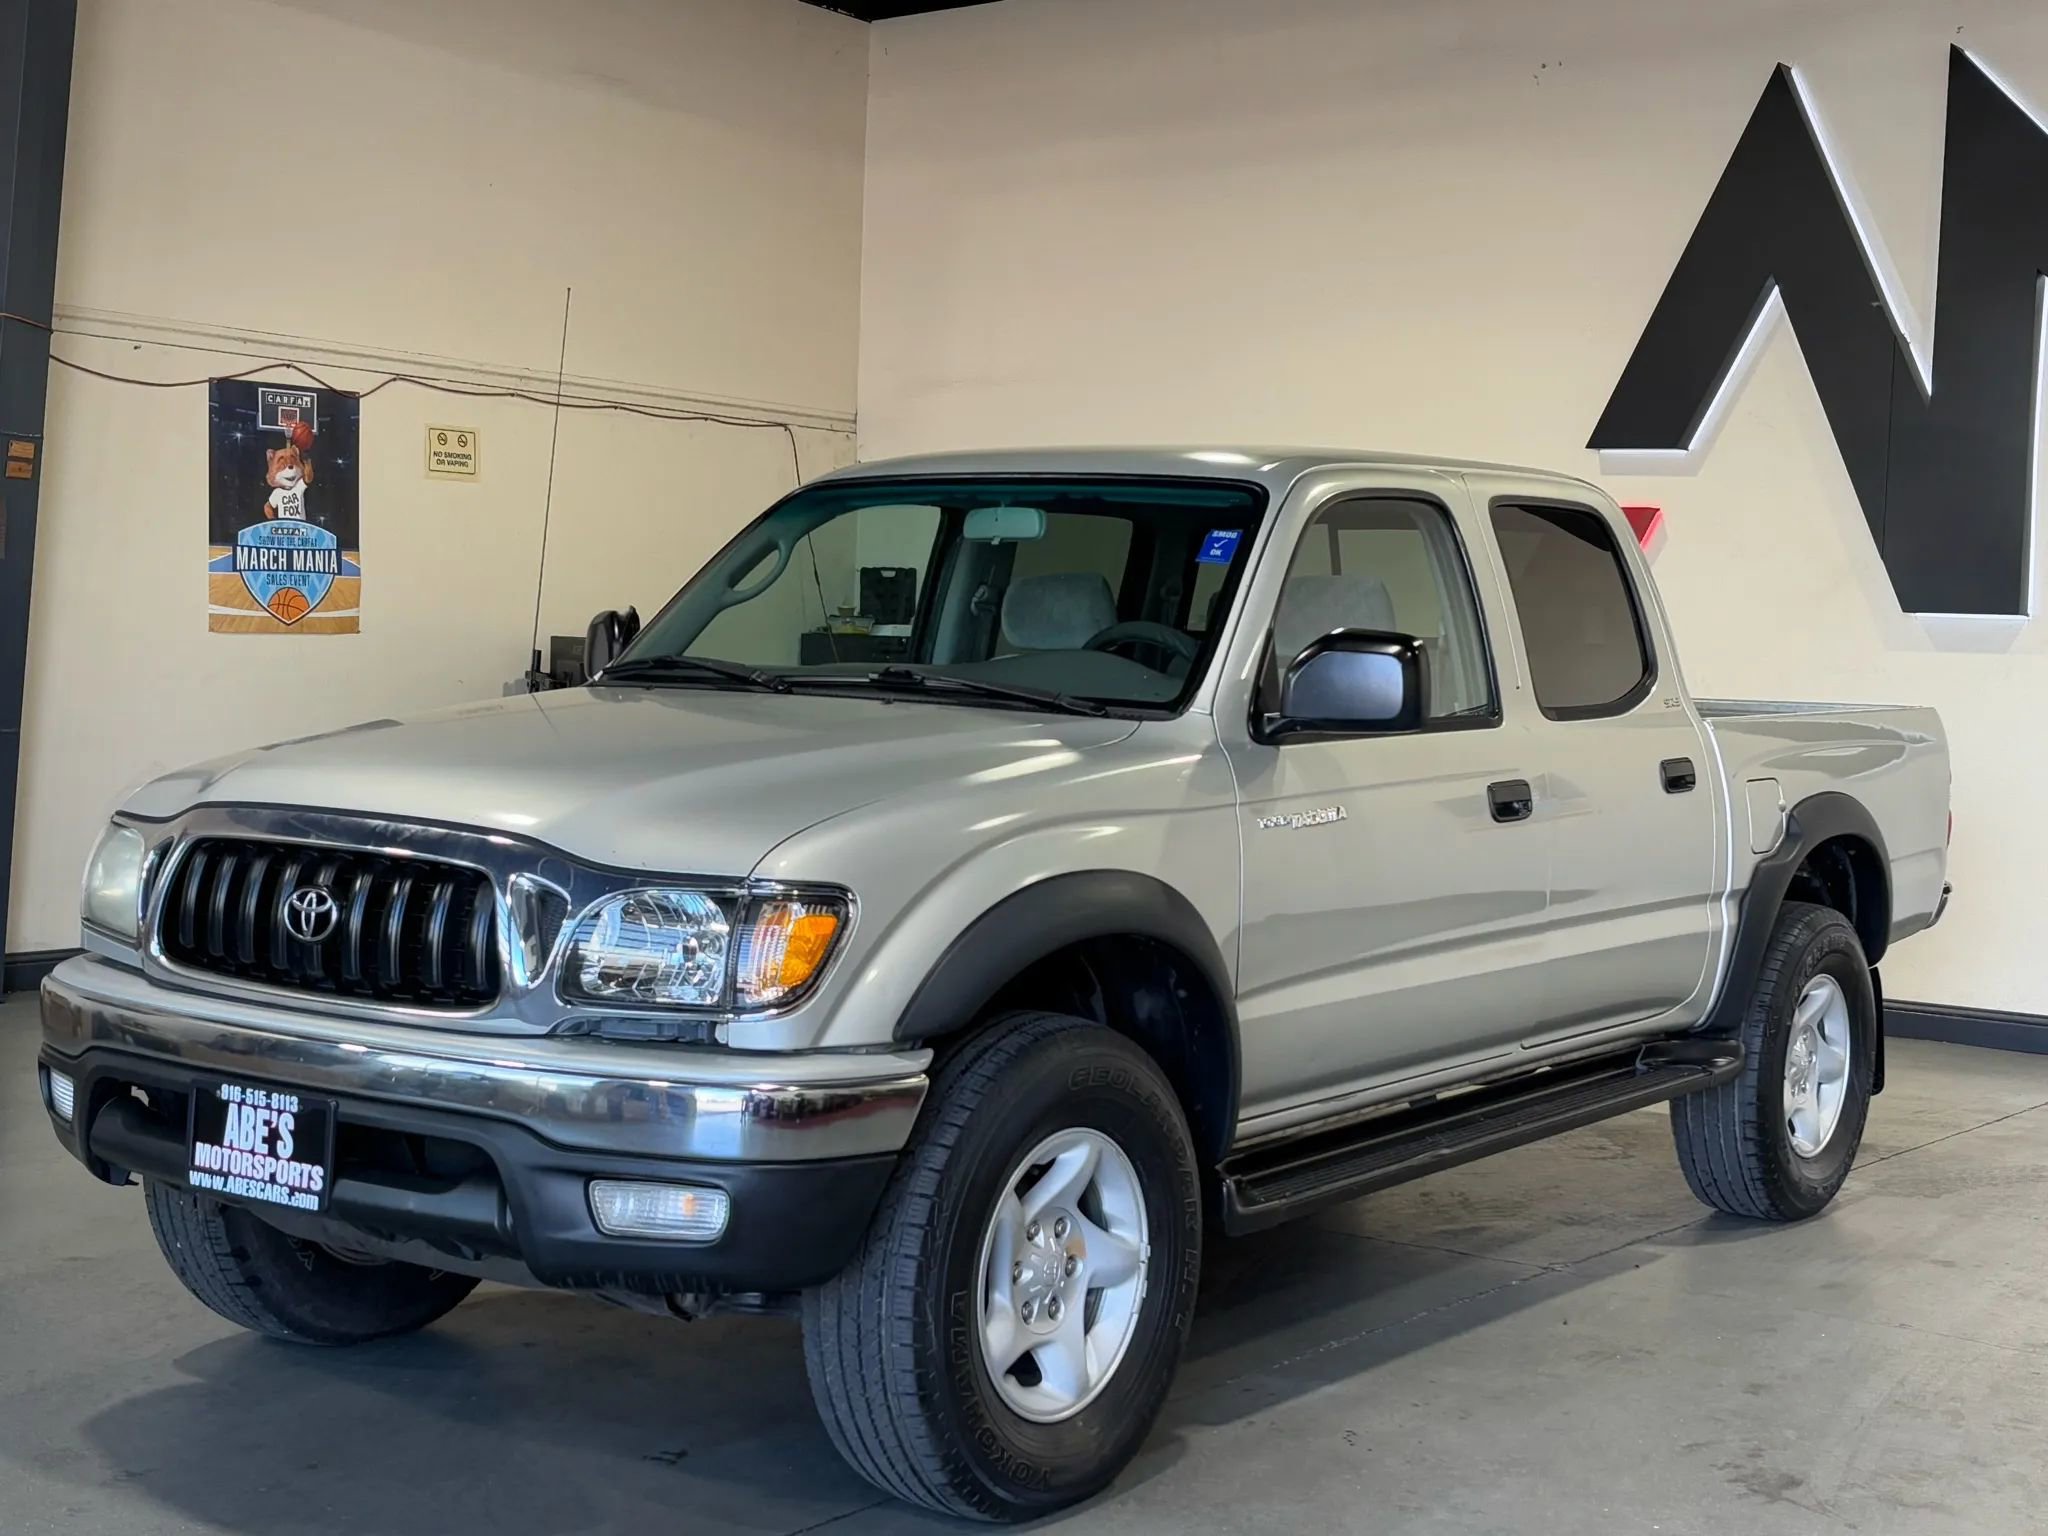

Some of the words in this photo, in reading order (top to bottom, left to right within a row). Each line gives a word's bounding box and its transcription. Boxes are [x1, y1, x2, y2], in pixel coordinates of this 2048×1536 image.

[266, 393, 311, 408] CARFAX
[433, 450, 443, 458] NO
[436, 458, 446, 466] OR
[281, 492, 299, 505] CAR
[283, 504, 301, 517] FOX
[271, 527, 307, 537] CARFAX
[258, 536, 276, 546] SHOW
[286, 537, 296, 547] THE
[297, 538, 318, 548] CARFAX
[236, 546, 287, 571] MARCH
[293, 550, 338, 574] MANIA
[266, 574, 287, 586] SALES
[289, 574, 310, 587] EVENT
[221, 1084, 299, 1113] 916-515-8113
[223, 1102, 295, 1159] ABE'S
[194, 1141, 324, 1191] MOTORSPORTS
